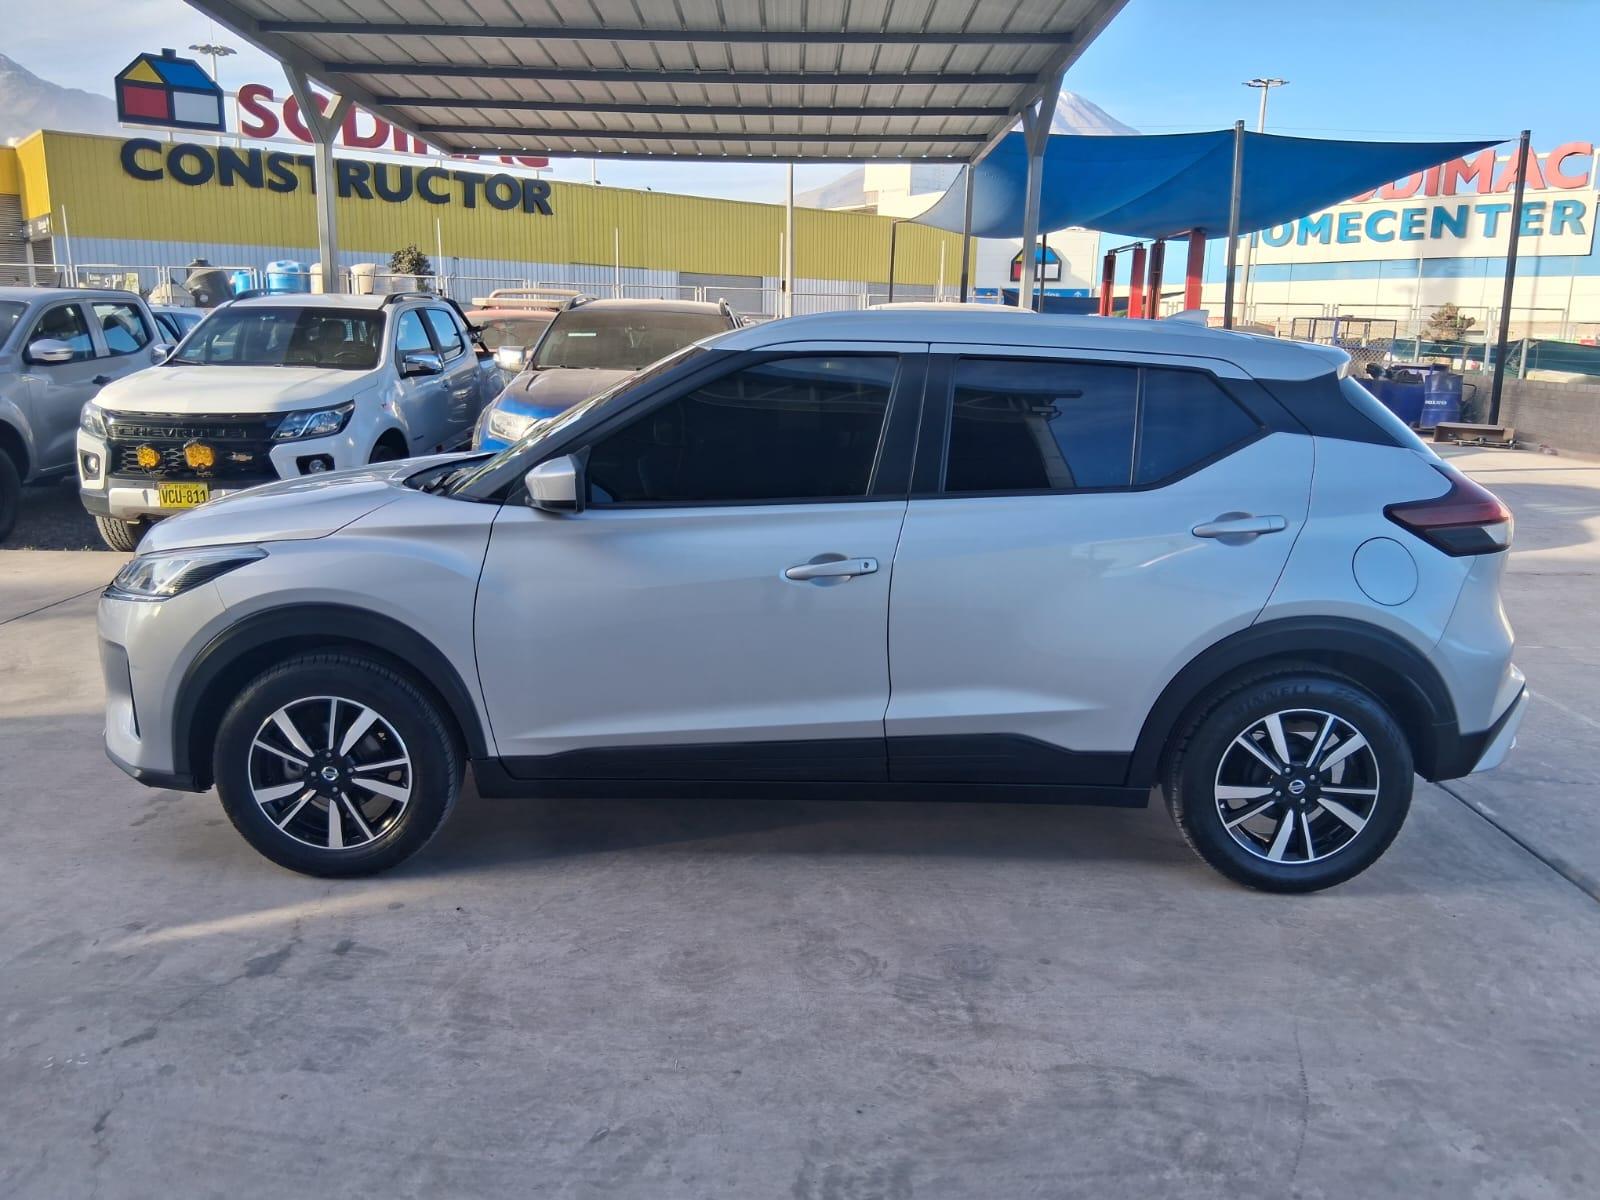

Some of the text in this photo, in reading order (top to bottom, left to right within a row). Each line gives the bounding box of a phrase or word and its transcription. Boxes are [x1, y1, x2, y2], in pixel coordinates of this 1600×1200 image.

[238, 83, 549, 168] SODI
[1351, 141, 1593, 202] DIMAC
[1237, 200, 1587, 249] OMECENTER
[161, 489, 207, 504] VCU-811
